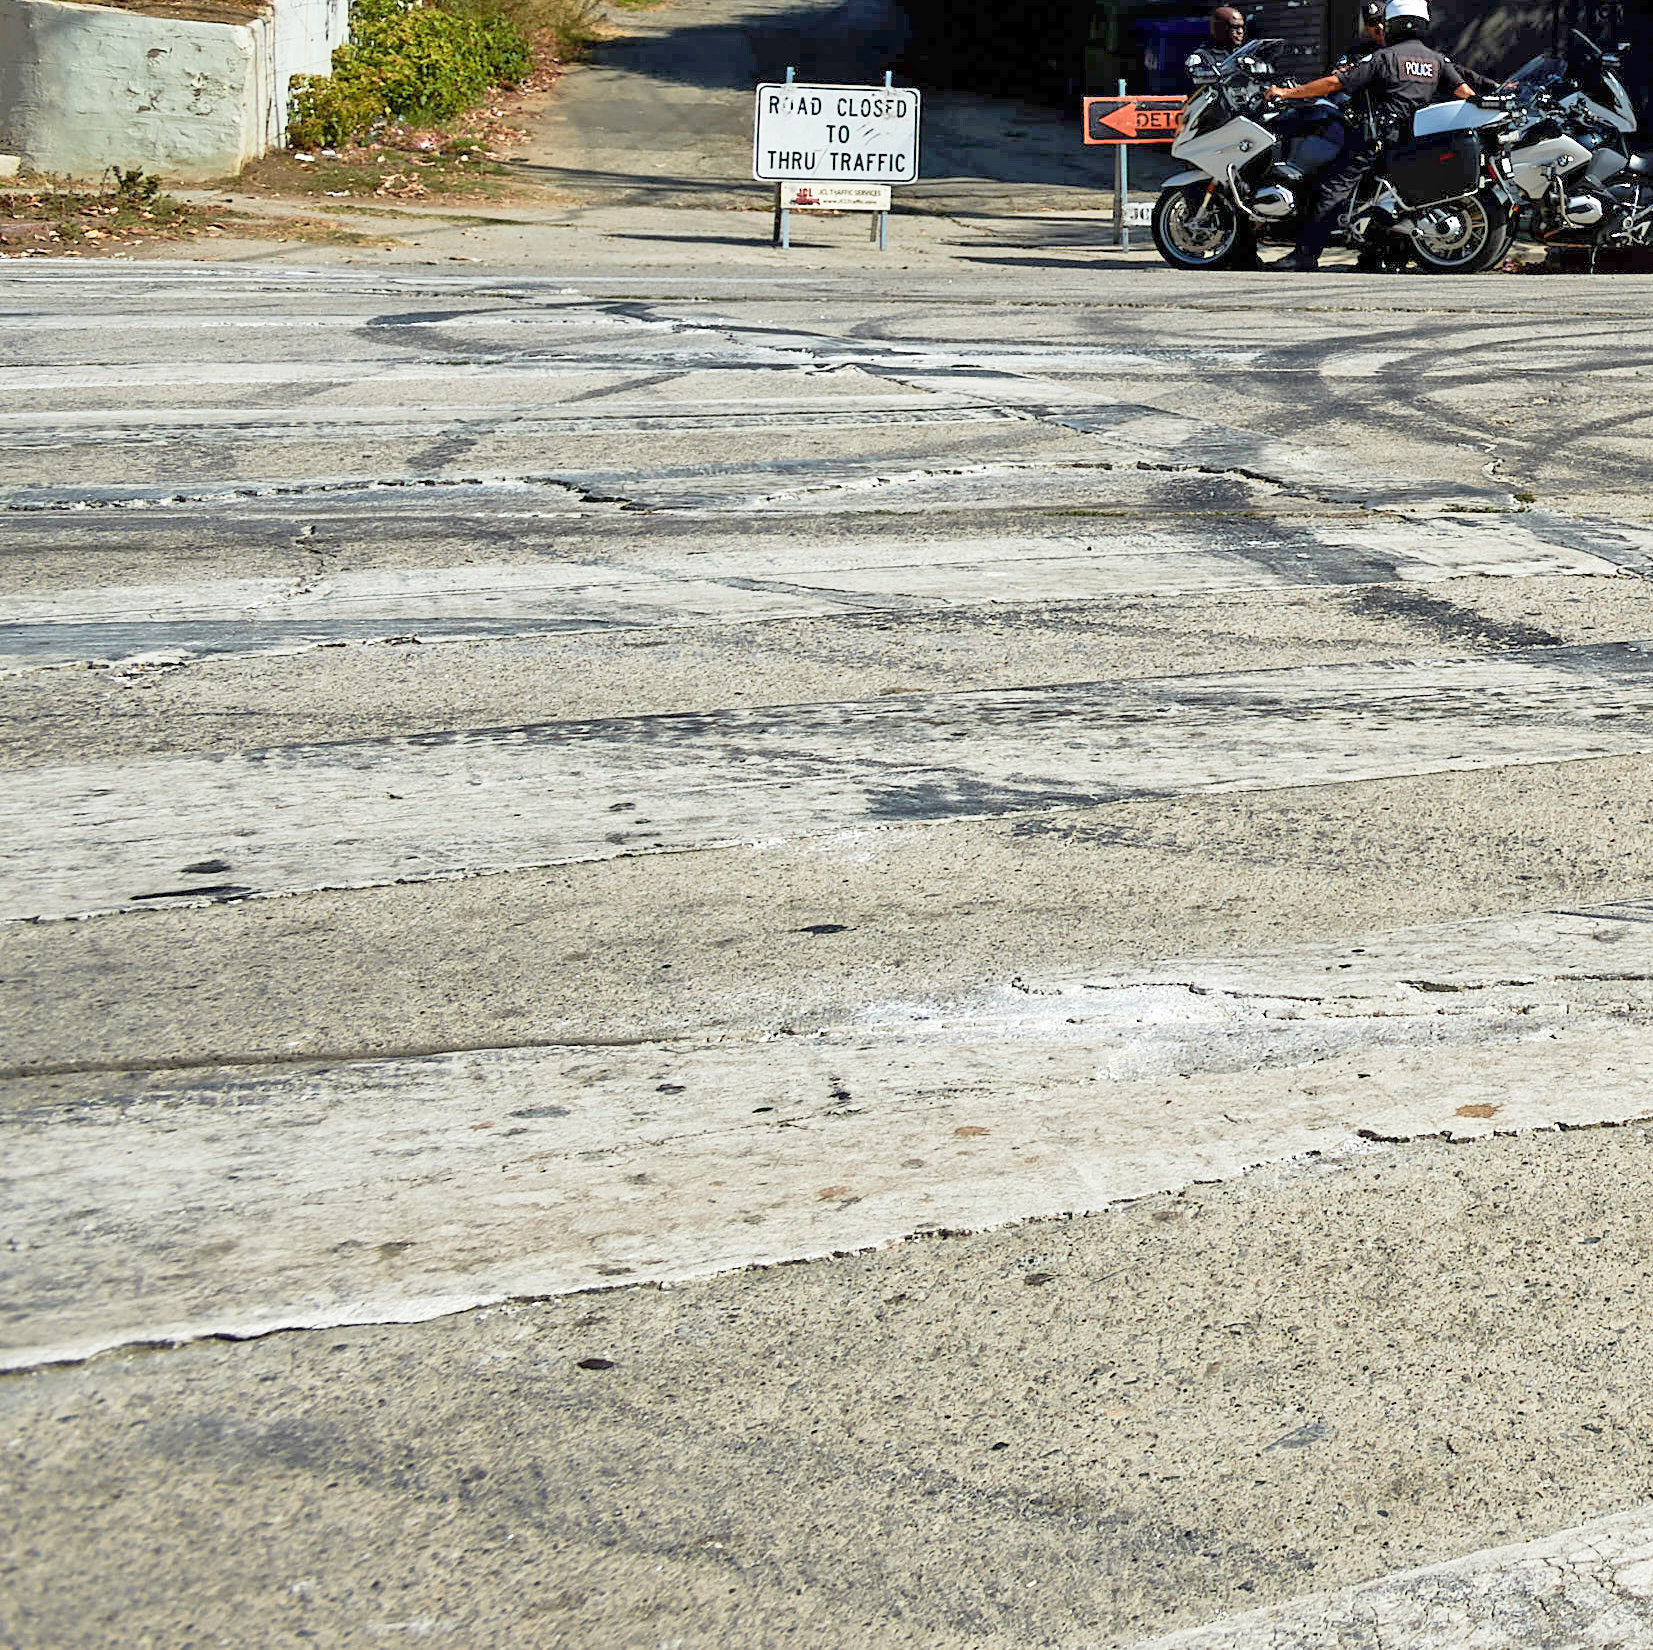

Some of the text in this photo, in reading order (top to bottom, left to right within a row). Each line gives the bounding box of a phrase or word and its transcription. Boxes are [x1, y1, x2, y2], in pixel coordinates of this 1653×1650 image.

[1405, 61, 1433, 77] POLICE
[837, 98, 907, 118] CLOSED
[826, 125, 850, 144] TO
[768, 150, 906, 172] THRU TRAFFIC
